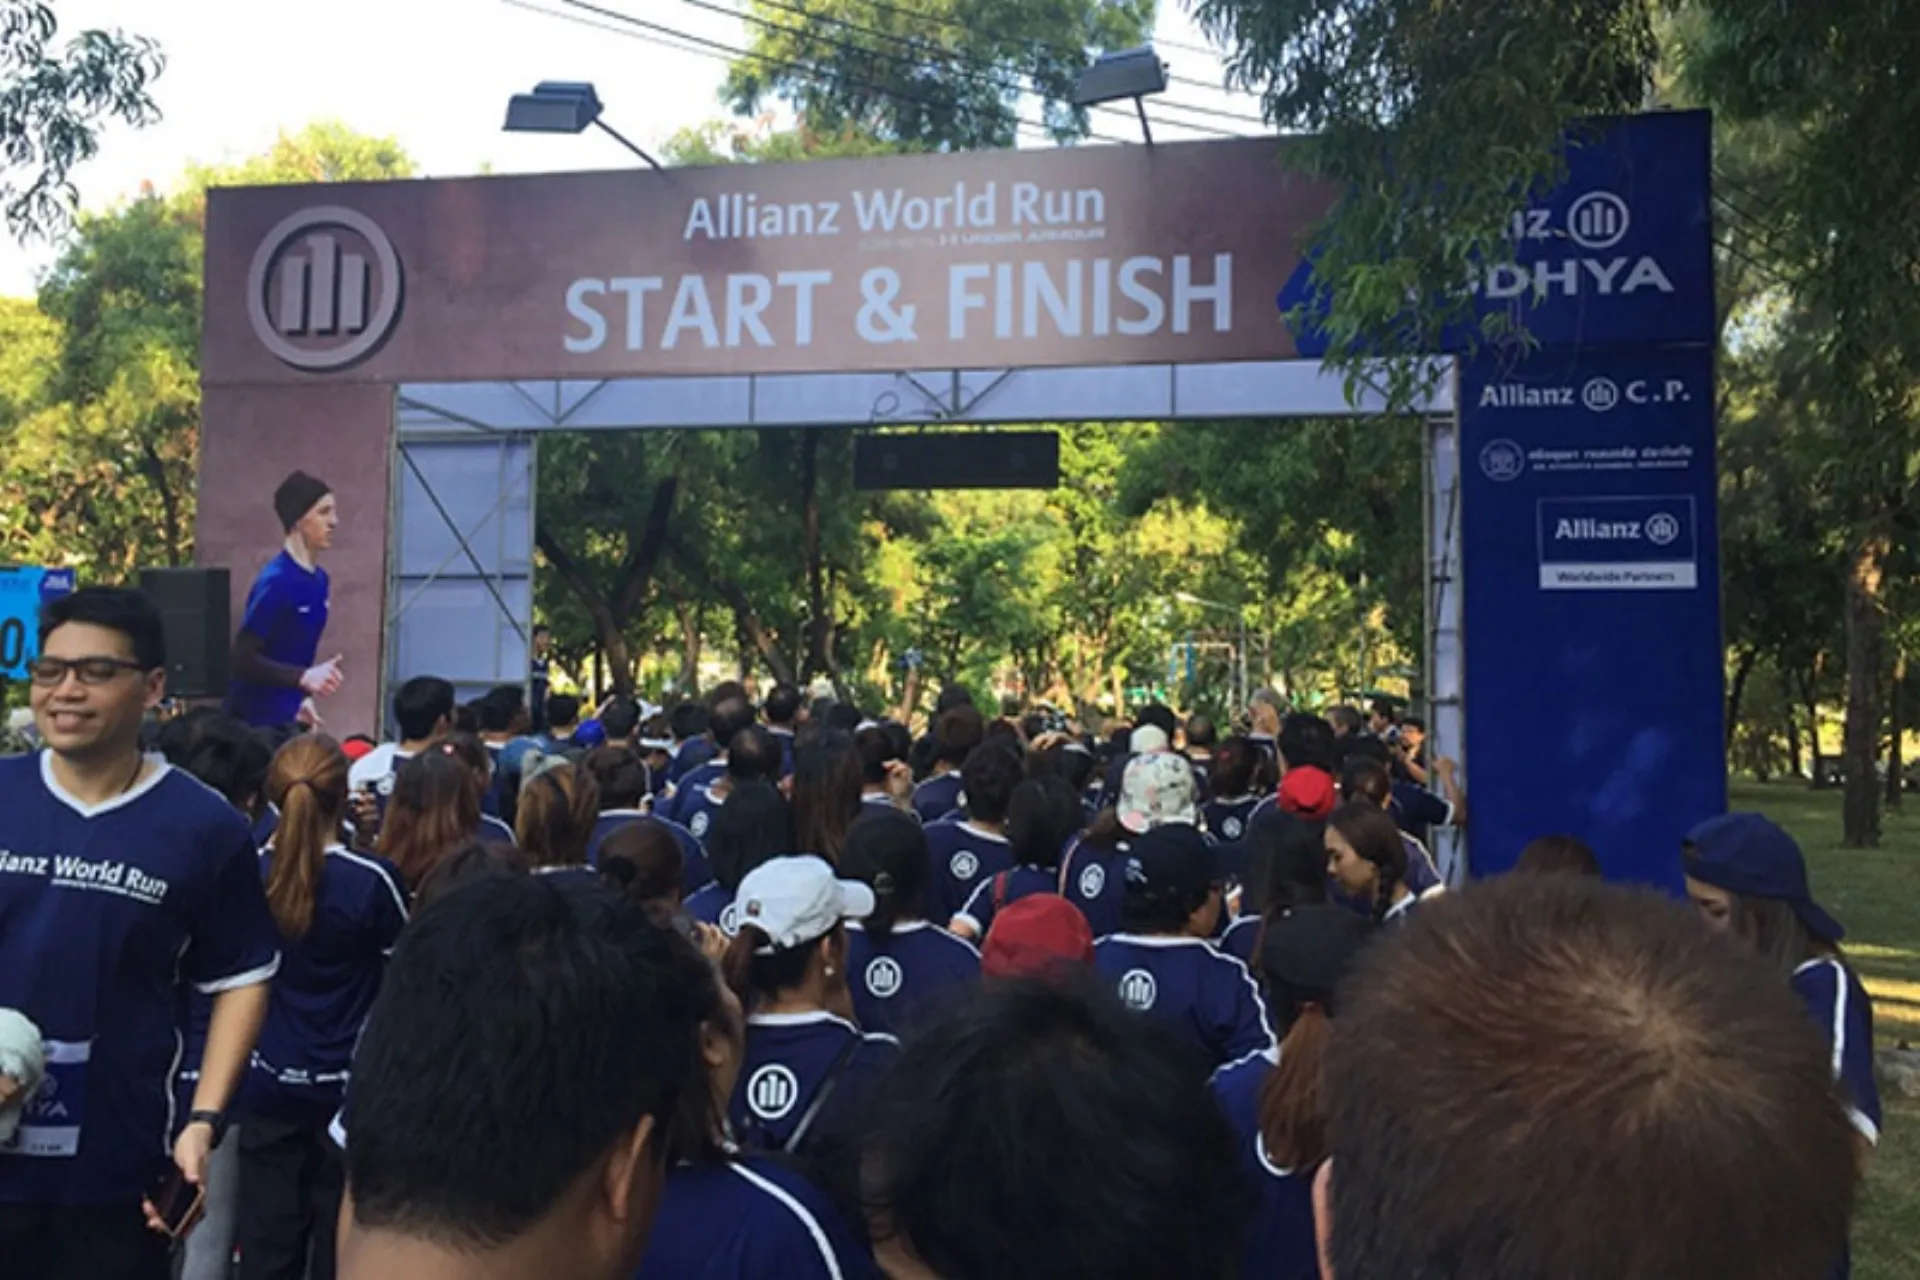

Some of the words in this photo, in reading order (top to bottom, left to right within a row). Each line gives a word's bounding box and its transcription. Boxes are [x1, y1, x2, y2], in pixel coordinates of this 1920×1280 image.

[685, 194, 840, 240] Allianz
[853, 182, 995, 230] World
[1012, 185, 1106, 225] Run
[563, 270, 831, 353] START
[857, 268, 918, 343] &
[948, 253, 1232, 340] FINISH
[1479, 384, 1574, 408] Allianz
[1555, 518, 1641, 539] Allianz
[54, 854, 125, 884] World
[125, 866, 168, 898] Run
